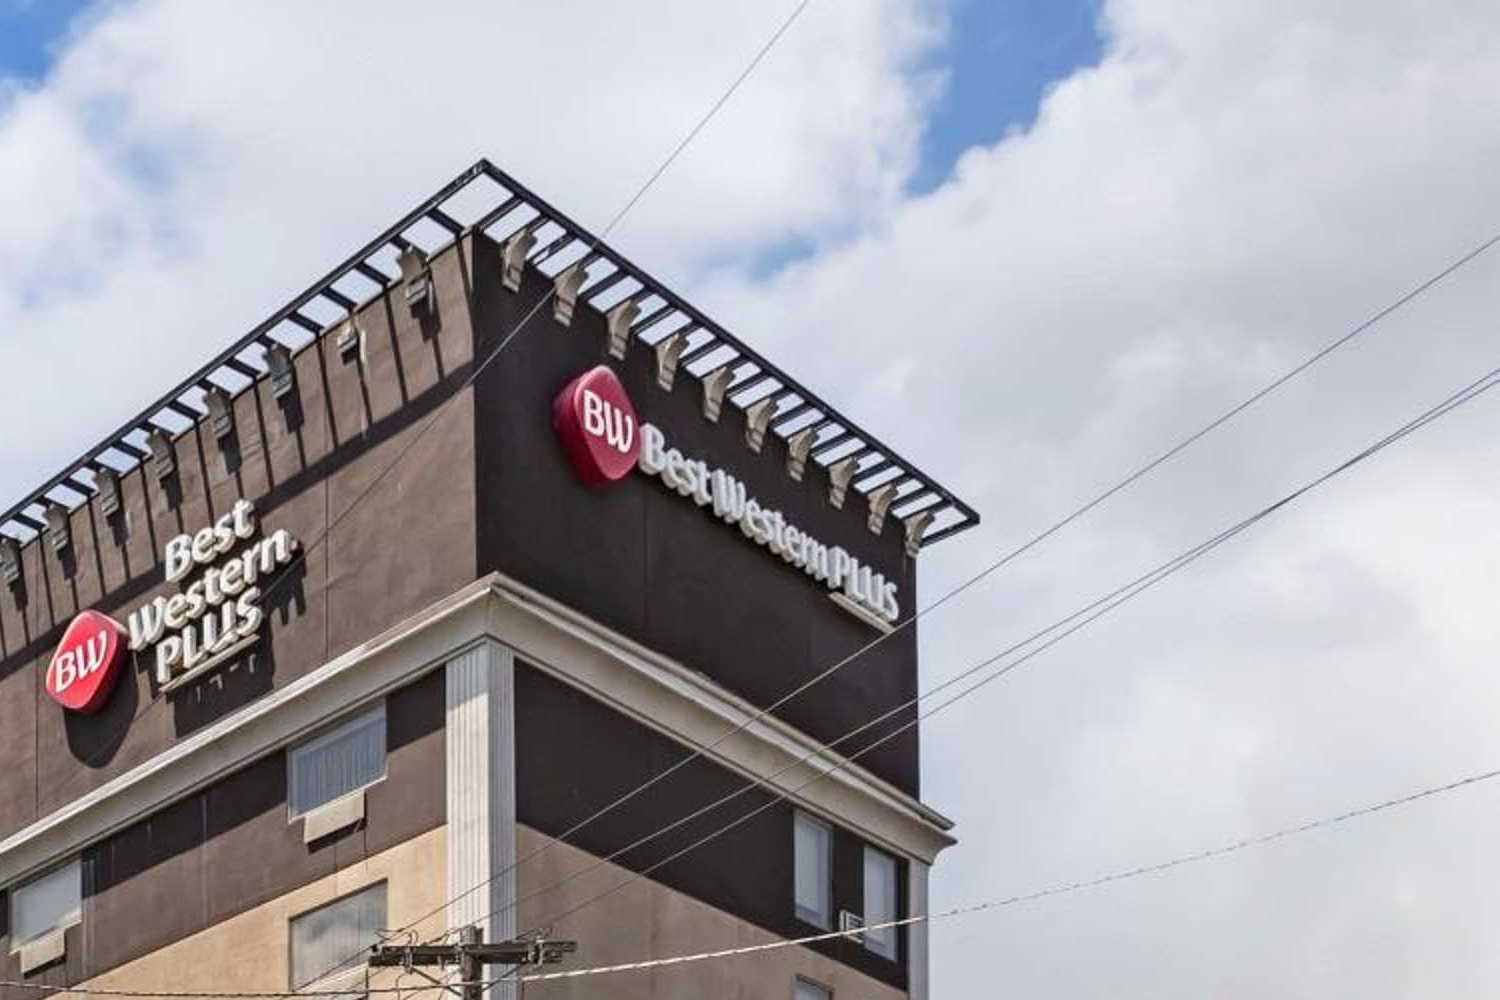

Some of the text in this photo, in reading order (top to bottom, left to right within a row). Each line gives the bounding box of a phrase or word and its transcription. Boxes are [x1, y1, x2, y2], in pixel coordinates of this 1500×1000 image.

[583, 389, 633, 453] BW
[164, 498, 256, 582] Best
[638, 422, 712, 506] Best
[711, 468, 828, 581] Western
[128, 528, 293, 652] Western
[156, 586, 264, 684] PLUS
[55, 629, 107, 694] BW
